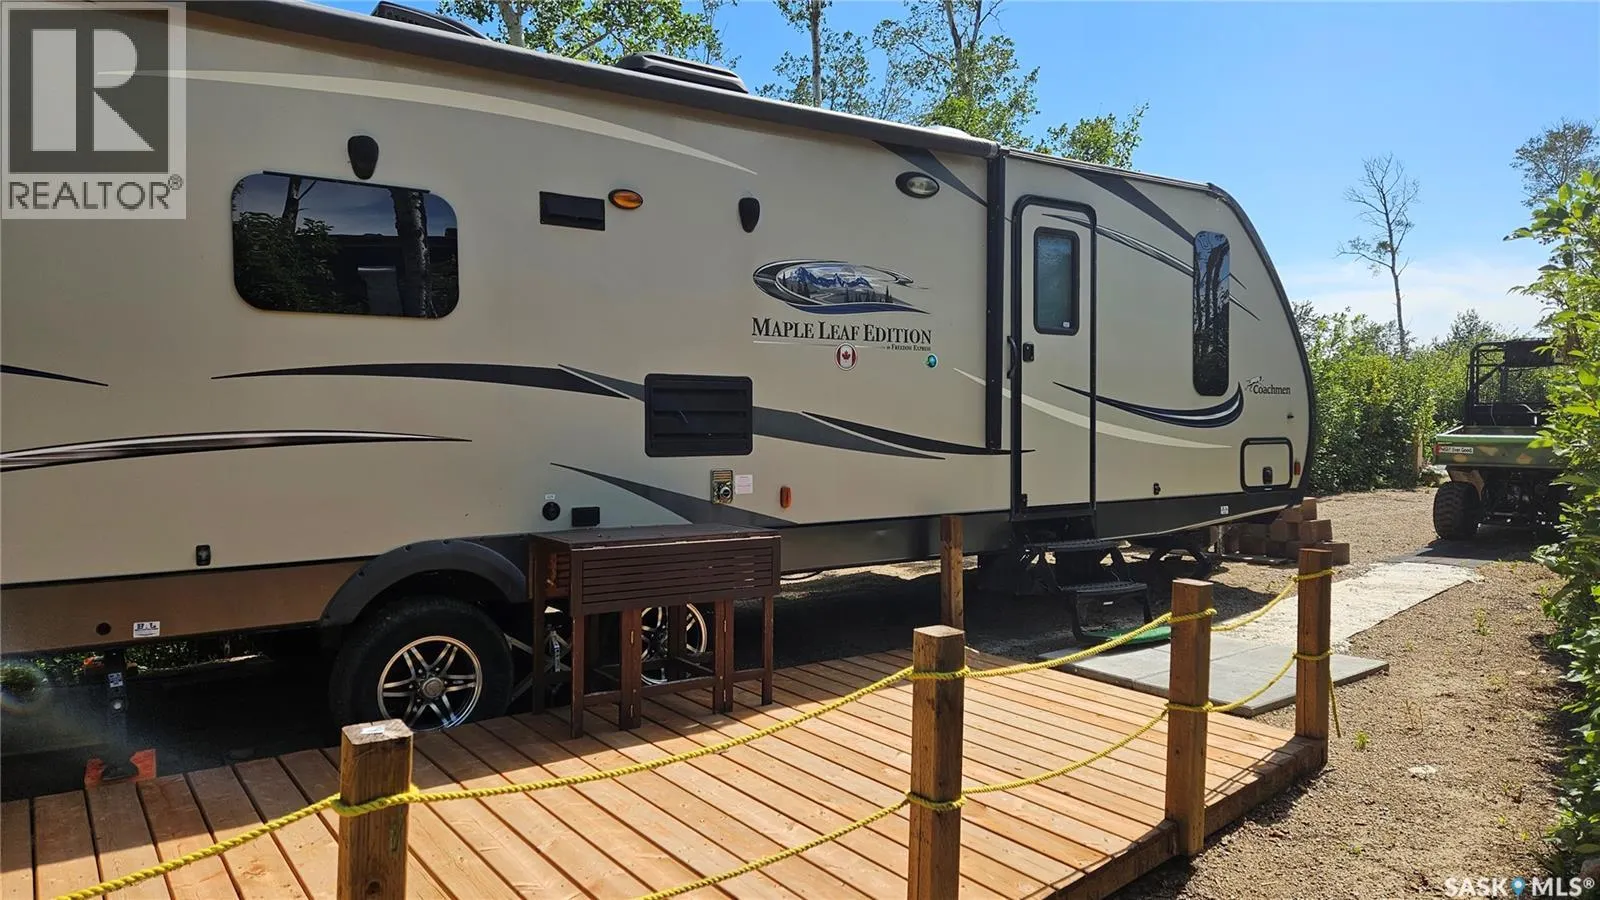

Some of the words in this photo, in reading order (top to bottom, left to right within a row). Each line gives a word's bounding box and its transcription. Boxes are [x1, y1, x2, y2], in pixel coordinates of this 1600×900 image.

[752, 317, 814, 339] MAPLE
[818, 321, 860, 341] LEAF
[863, 324, 931, 344] EDITION
[1253, 384, 1291, 395] Coachmen
